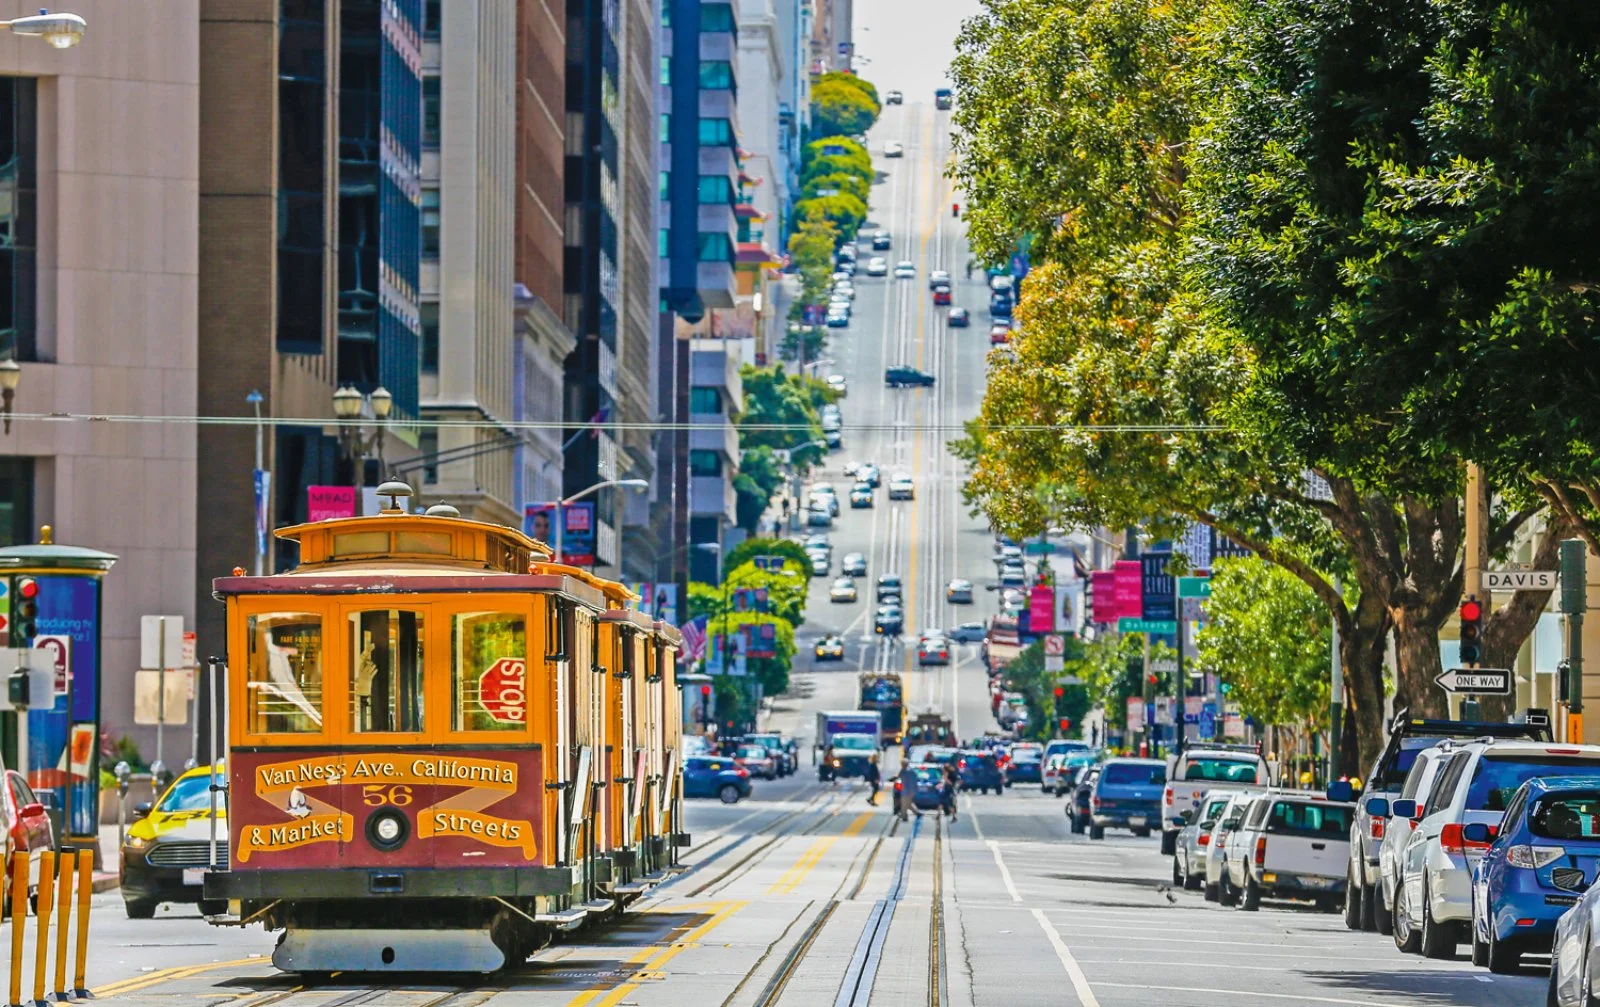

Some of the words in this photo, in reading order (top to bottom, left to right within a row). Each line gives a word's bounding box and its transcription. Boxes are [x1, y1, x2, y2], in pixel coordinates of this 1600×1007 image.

[1489, 574, 1548, 586] DAVIS
[1125, 622, 1168, 630] Battery
[500, 661, 525, 720] STOP
[1456, 676, 1477, 686] ONE
[1479, 676, 1501, 686] WAY
[260, 766, 297, 787] Van
[298, 763, 348, 782] Ness
[411, 759, 514, 782] California
[362, 785, 413, 806] 56
[251, 827, 266, 846] &
[269, 817, 344, 846] Market
[433, 813, 521, 840] Streets
